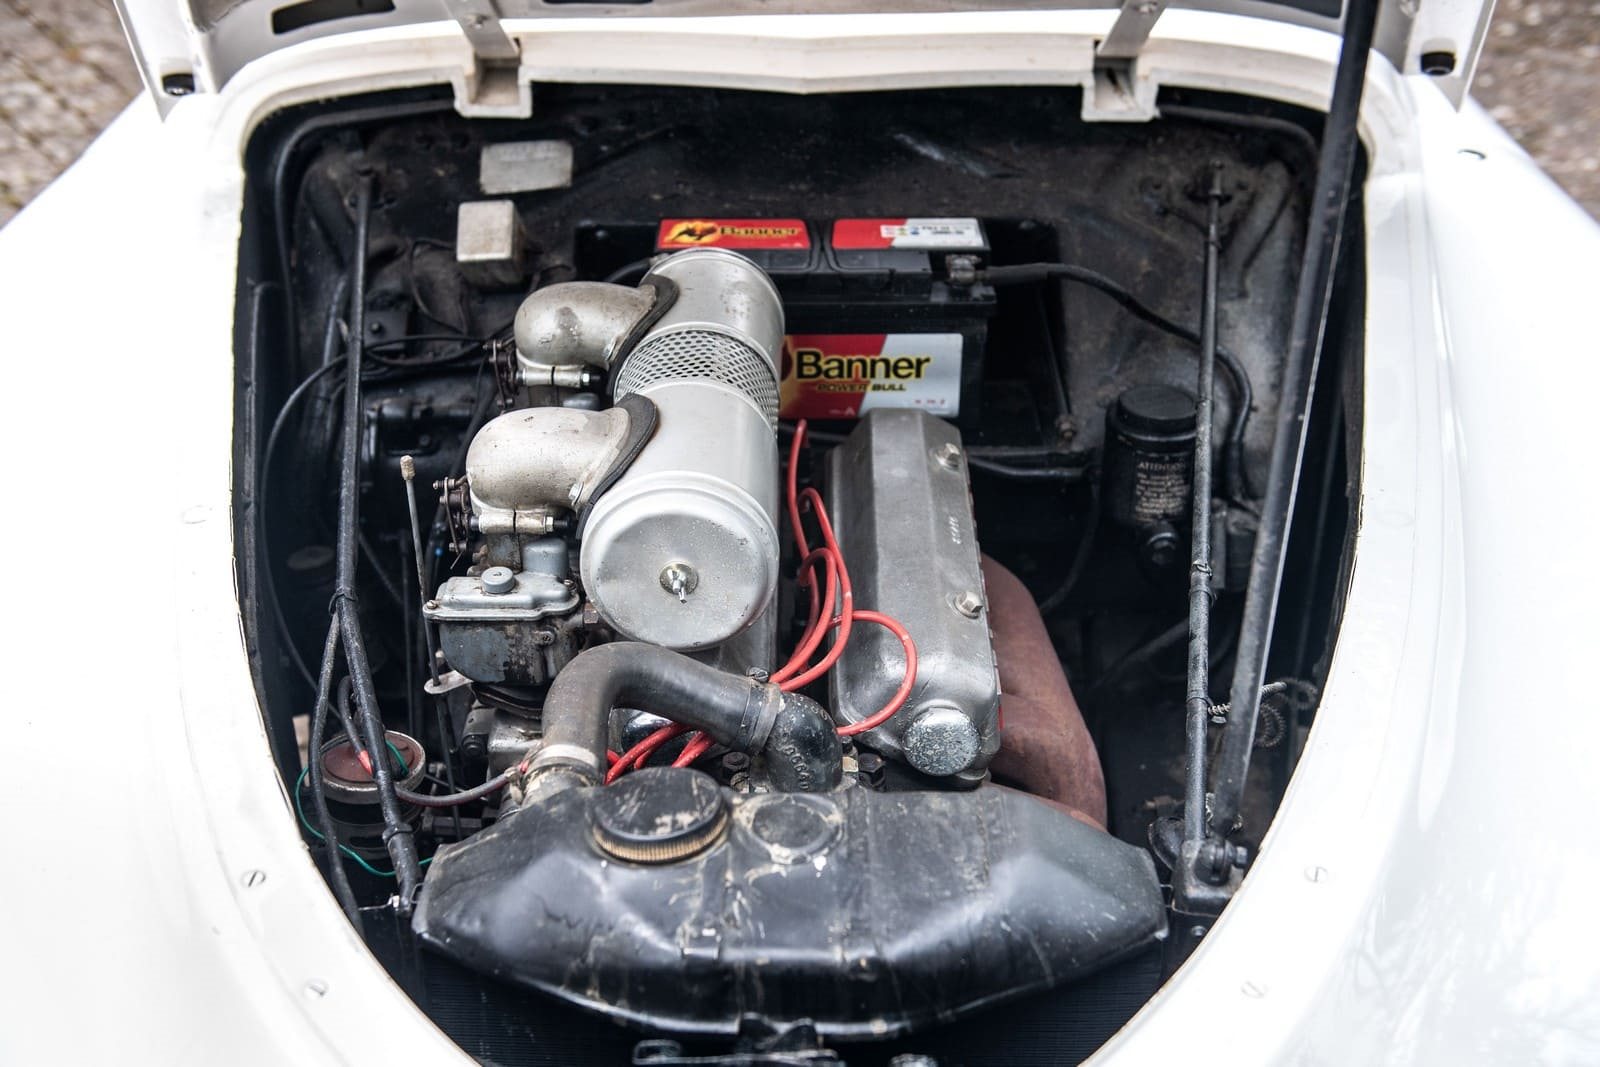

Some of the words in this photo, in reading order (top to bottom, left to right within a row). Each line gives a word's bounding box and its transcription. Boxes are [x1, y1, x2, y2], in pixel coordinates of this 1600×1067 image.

[719, 225, 798, 237] Banner
[796, 350, 931, 380] Banner
[816, 383, 869, 391] POWER
[871, 383, 906, 391] BULL
